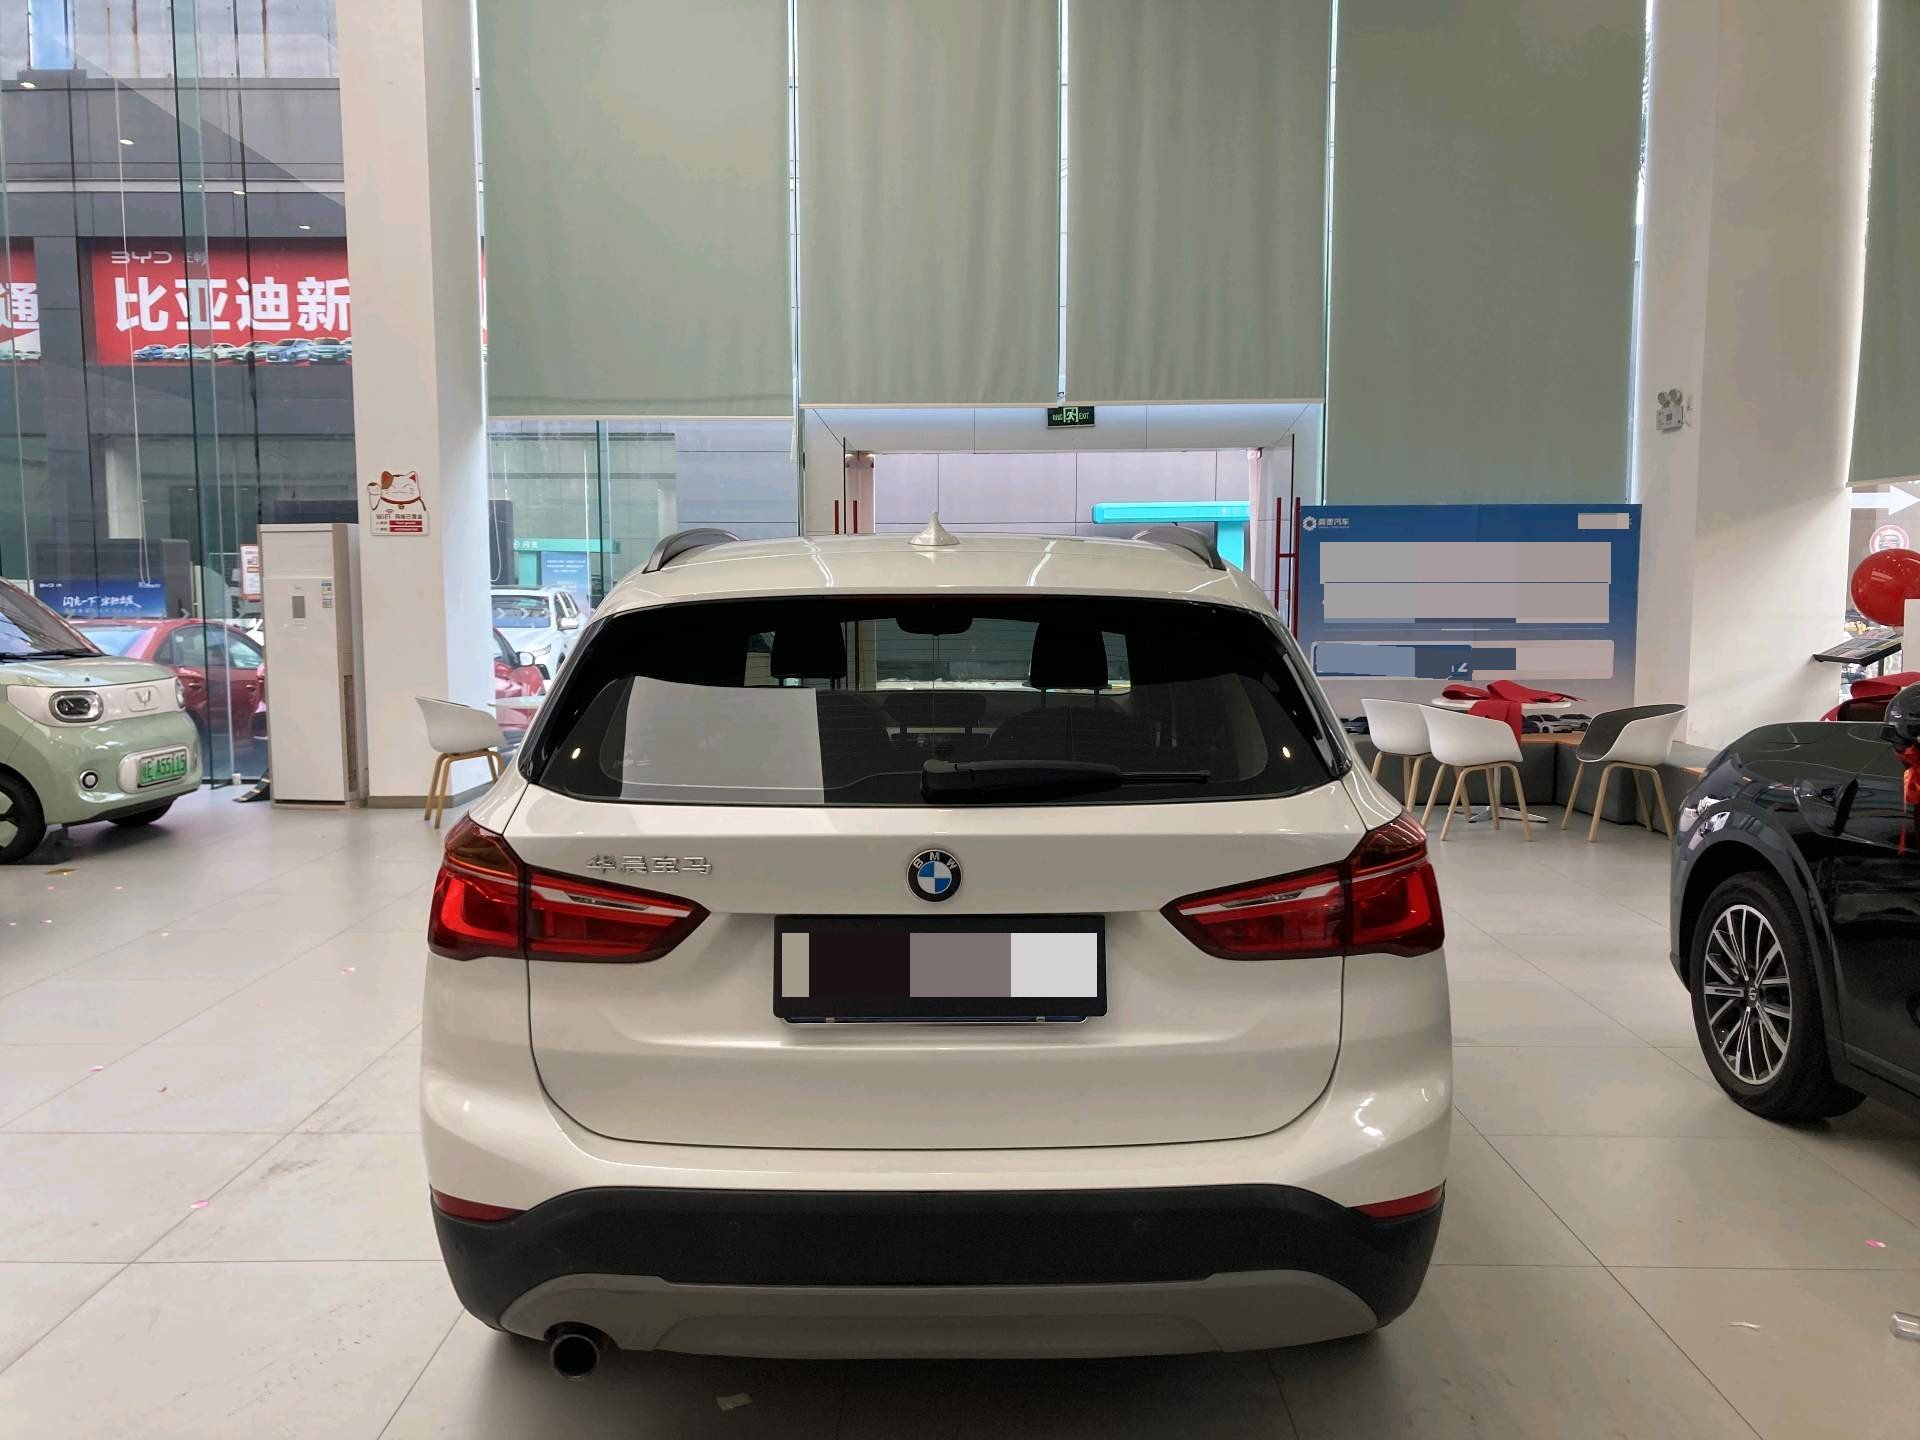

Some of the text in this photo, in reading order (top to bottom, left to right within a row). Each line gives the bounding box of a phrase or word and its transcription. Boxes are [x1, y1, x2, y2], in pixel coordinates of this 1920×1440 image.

[111, 251, 172, 263] BYD
[0, 283, 39, 329] 通
[114, 276, 350, 332] 比亚迪新
[1078, 412, 1089, 420] EXIT
[586, 854, 712, 874] 华晨宝马
[913, 851, 958, 870] BMW
